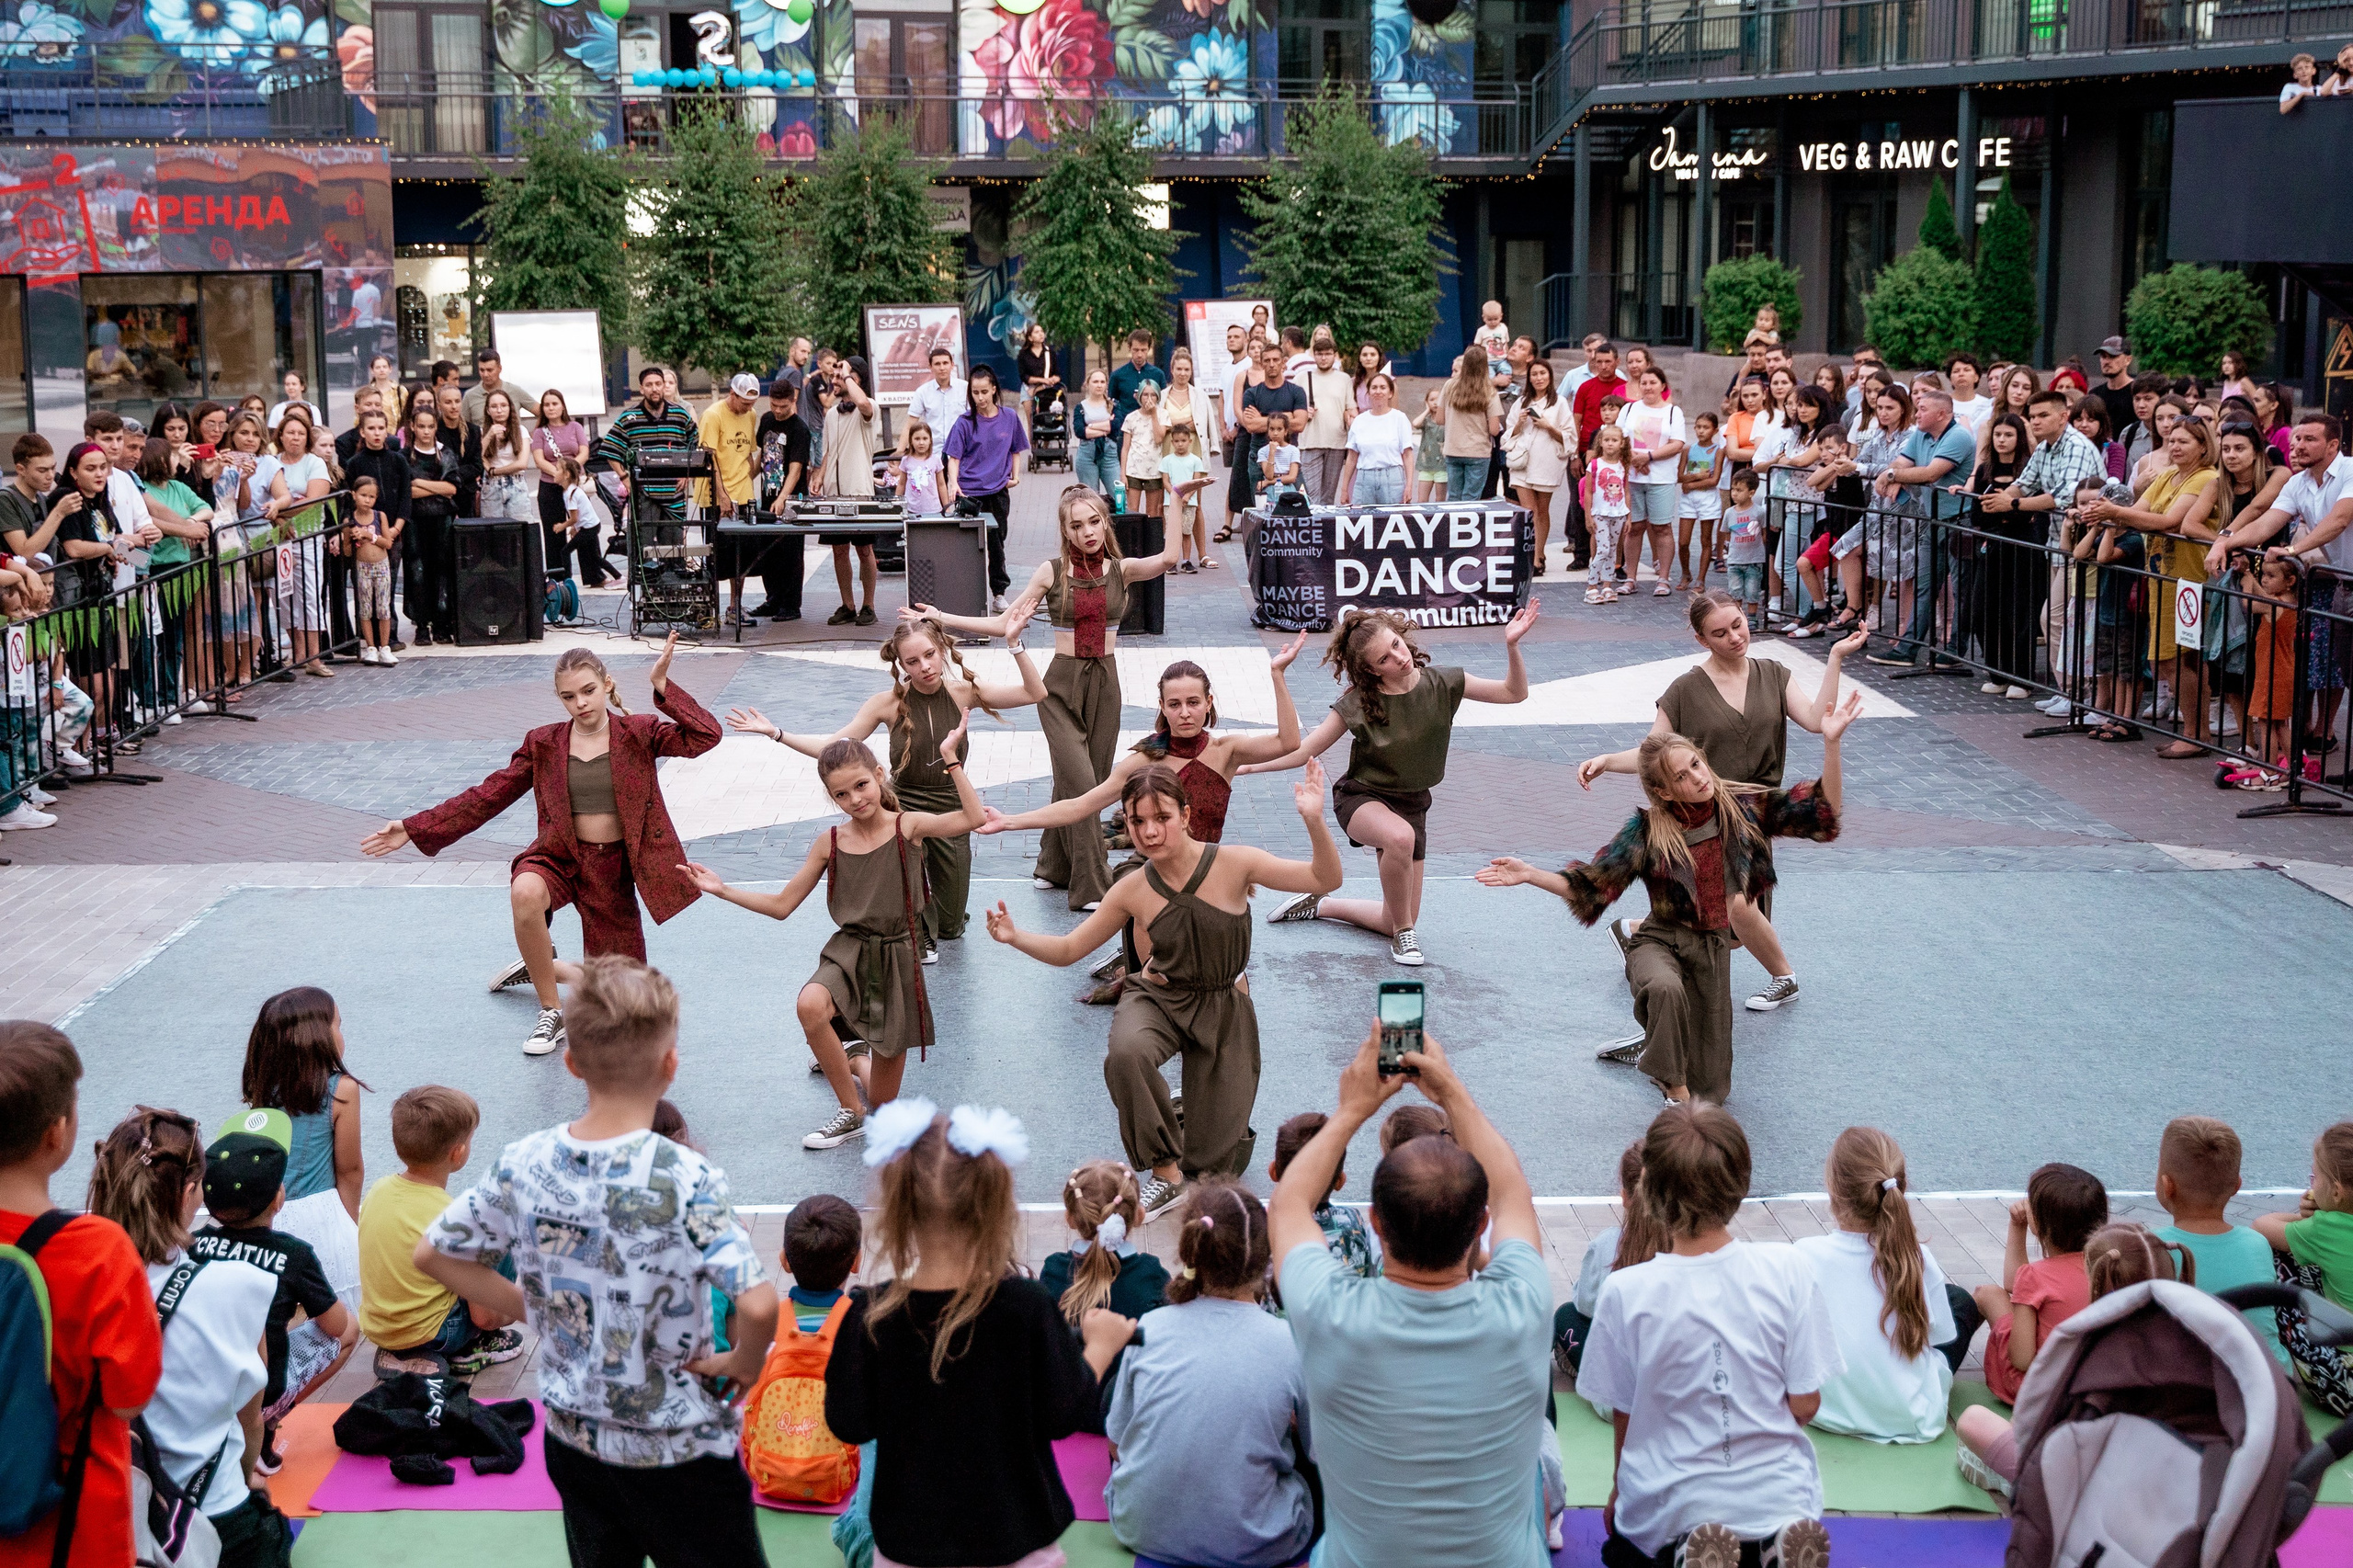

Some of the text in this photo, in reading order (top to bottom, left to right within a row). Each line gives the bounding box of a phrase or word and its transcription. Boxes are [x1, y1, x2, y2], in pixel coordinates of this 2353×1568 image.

[1799, 137, 2011, 171] VEG & RAW CFE
[130, 194, 291, 231] АРЕНДА
[879, 314, 917, 329] SENS
[1260, 529, 1324, 544] DANCE
[1336, 510, 1515, 550] MAYBE
[1260, 546, 1324, 558] Community
[1336, 555, 1515, 597] DANCE
[1262, 585, 1325, 601] MAYBE
[1264, 603, 1327, 618] DANCE
